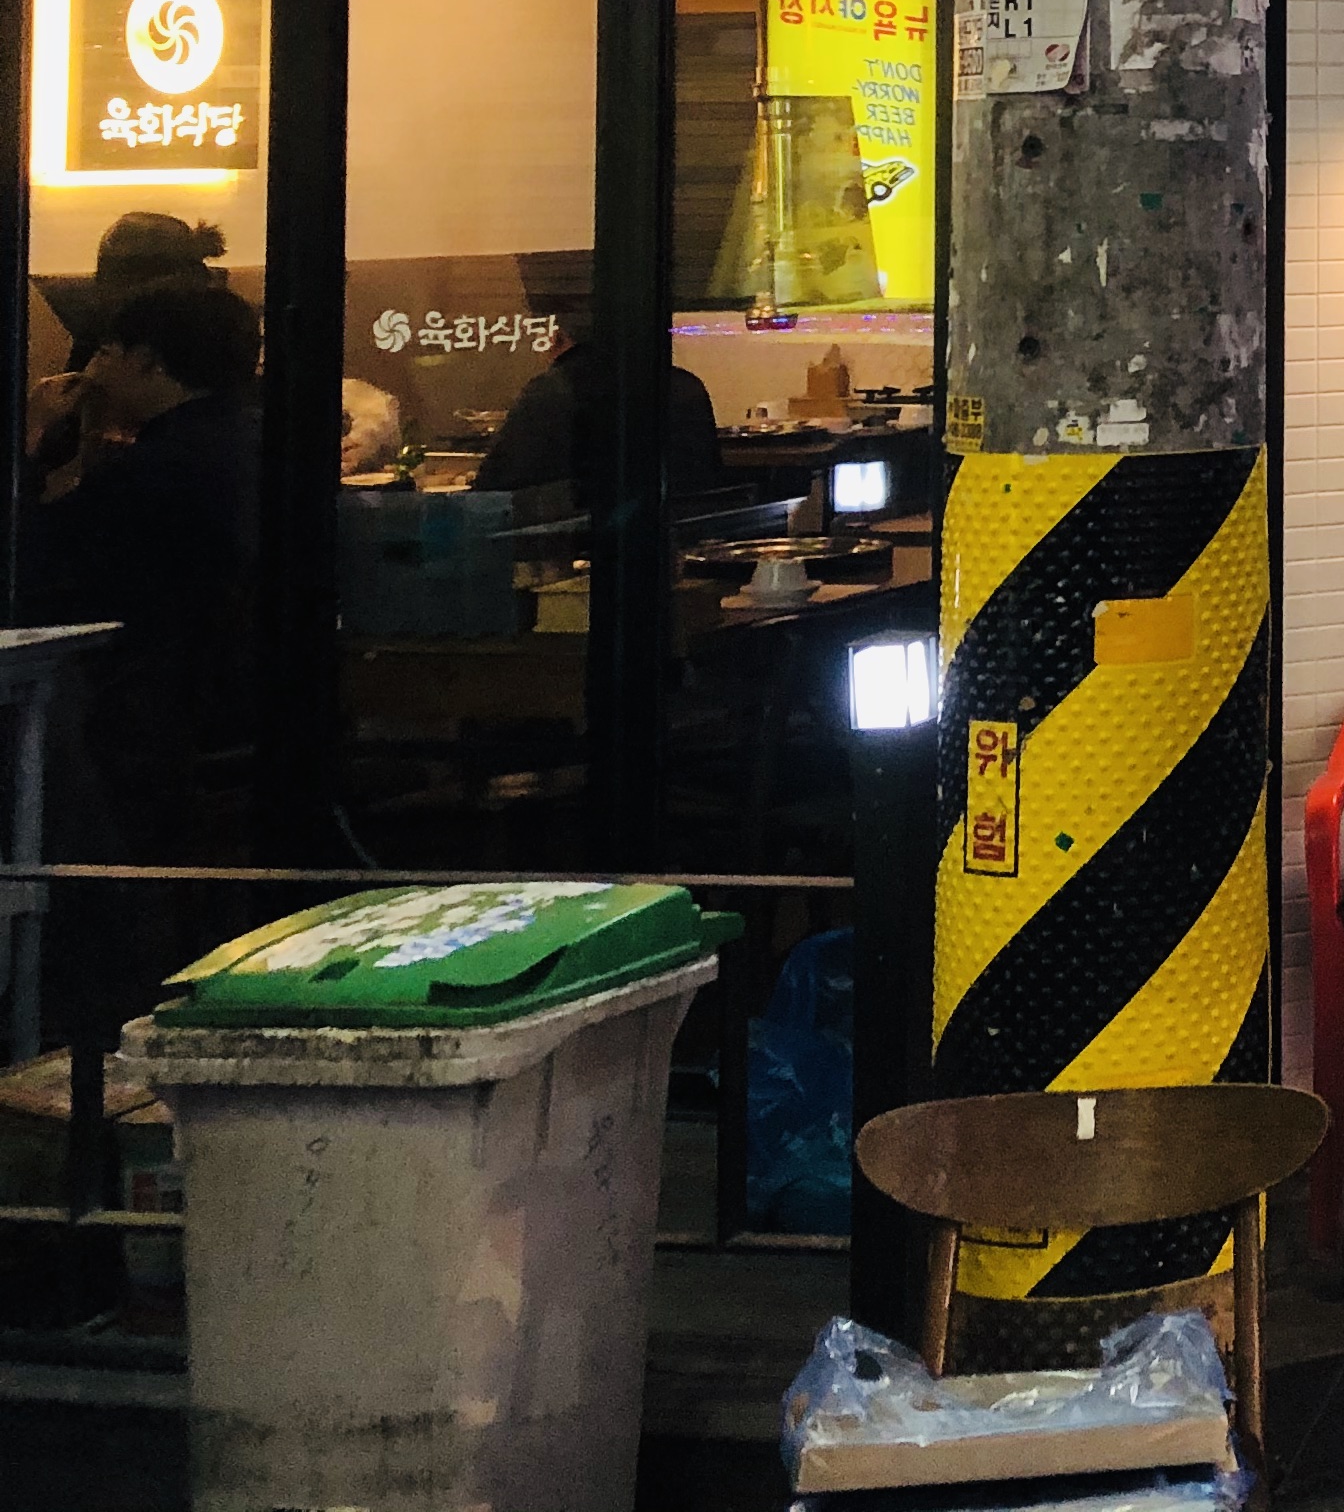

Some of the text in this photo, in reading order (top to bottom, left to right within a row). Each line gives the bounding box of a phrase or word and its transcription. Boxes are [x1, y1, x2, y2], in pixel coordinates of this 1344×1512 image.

[1005, 18, 1034, 38] L1
[99, 97, 245, 148] 육화식당
[418, 311, 559, 352] 육화식당
[973, 729, 1008, 862] 위험
